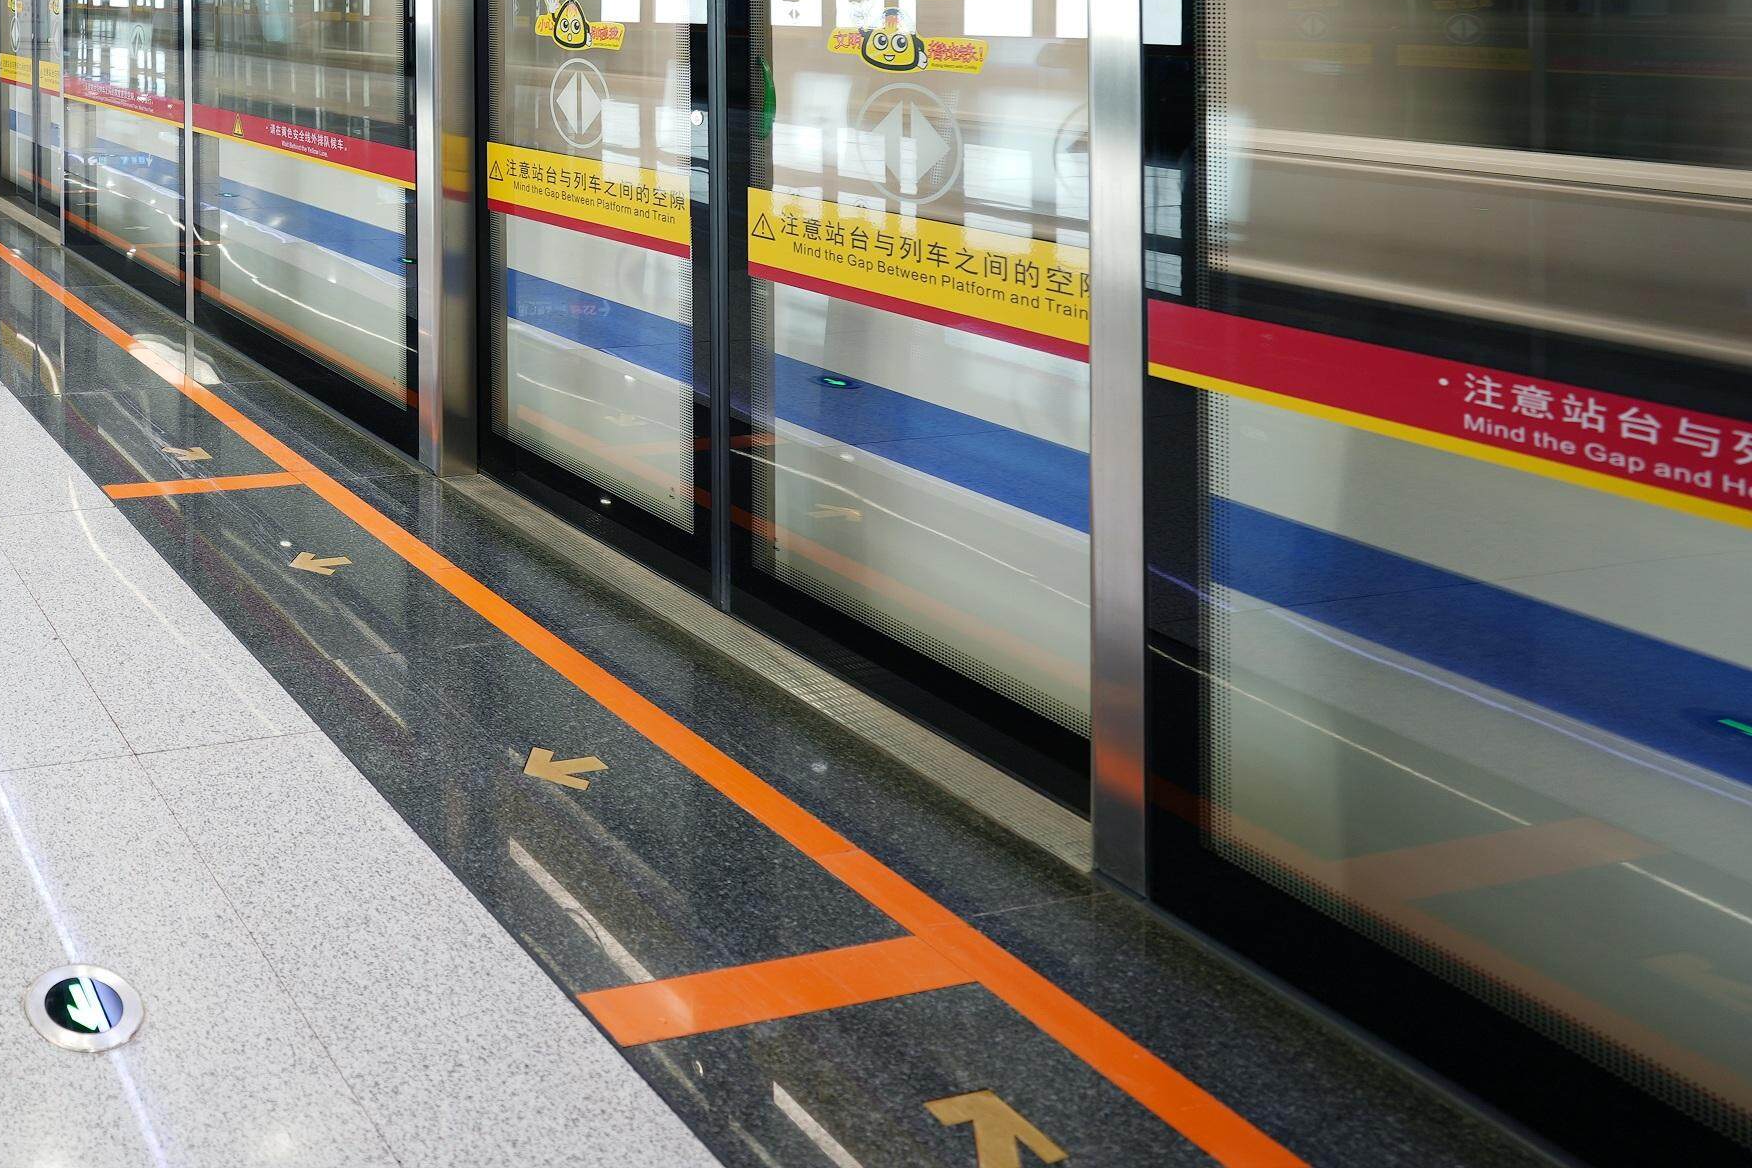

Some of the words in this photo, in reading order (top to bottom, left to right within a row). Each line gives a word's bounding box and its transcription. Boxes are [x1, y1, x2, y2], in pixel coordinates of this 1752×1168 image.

[506, 158, 685, 211] 注意站台与列车之间的空隙
[513, 180, 531, 193] Mind
[531, 184, 543, 196] the
[544, 188, 560, 201] Gap
[561, 191, 595, 207] Between
[597, 198, 632, 215] Platform
[633, 207, 650, 219] and
[651, 210, 676, 224] Train
[793, 242, 822, 260] Mind
[824, 248, 844, 265] the
[847, 254, 874, 275] Gap
[877, 260, 937, 286] Between
[941, 276, 1005, 302] Platform
[1010, 291, 1040, 309] and
[1046, 297, 1089, 320] Train
[1463, 413, 1526, 444] Mind
[1533, 429, 1577, 456] the
[1584, 441, 1646, 474] Gap
[1653, 462, 1712, 490] and
[1722, 474, 1752, 499] H
